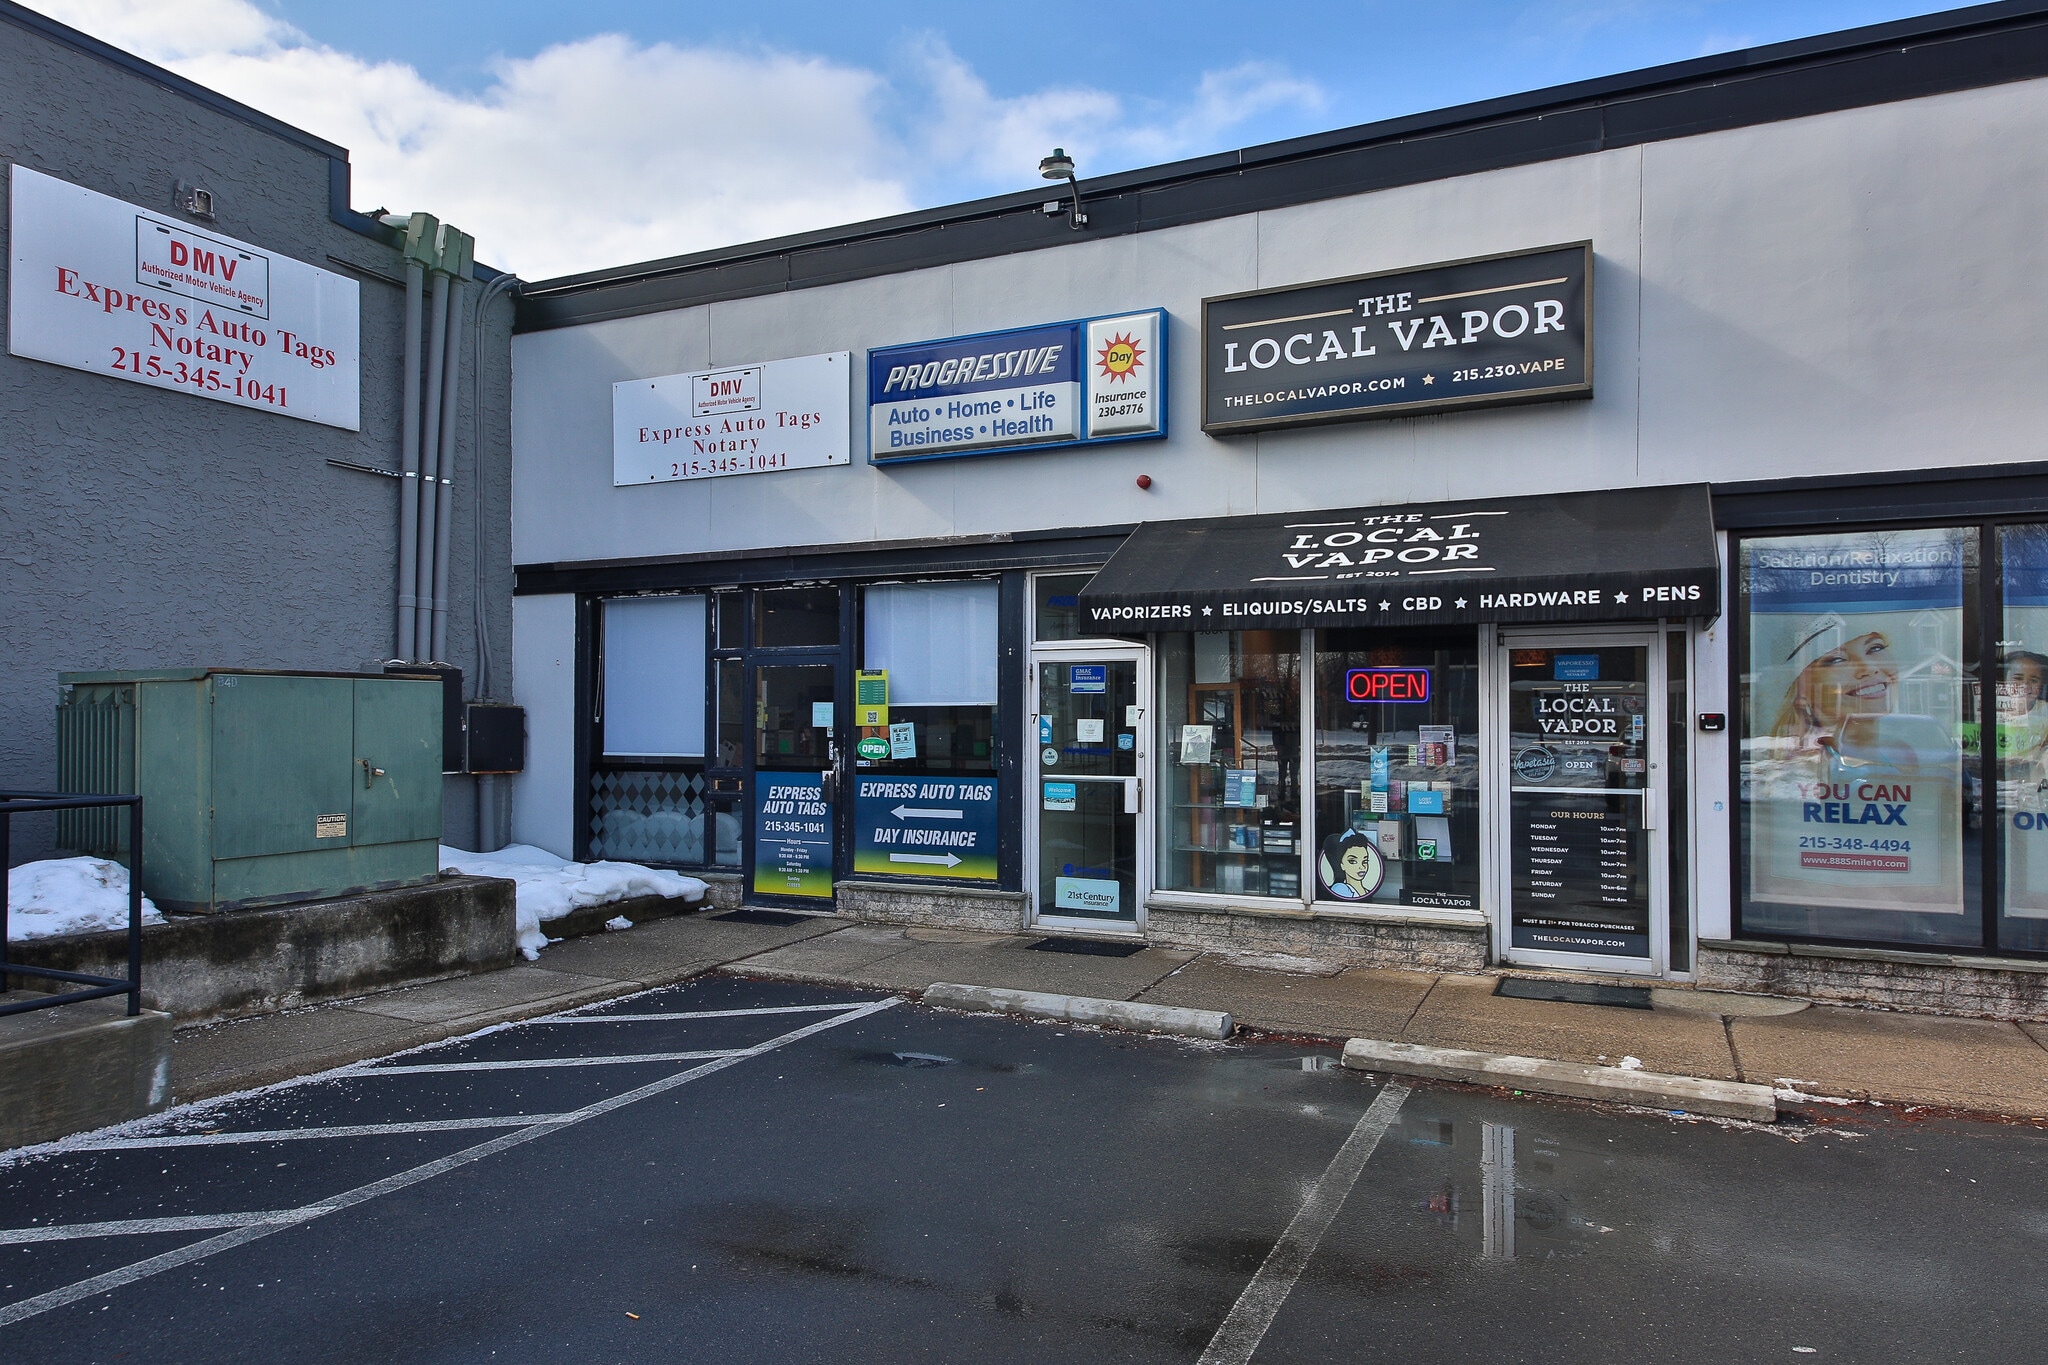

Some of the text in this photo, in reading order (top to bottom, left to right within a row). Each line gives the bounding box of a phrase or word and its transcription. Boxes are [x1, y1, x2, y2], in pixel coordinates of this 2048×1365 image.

[170, 240, 237, 282] DMV
[141, 261, 264, 308] Authorized Motor Vehicle Agency
[1358, 292, 1412, 318] THE
[55, 266, 336, 369] Express Auto Tags
[1224, 299, 1565, 373] LOCAL VAPOR
[149, 322, 254, 375] Notary
[1109, 351, 1132, 365] Day
[110, 346, 288, 408] 215-345-1041
[883, 345, 1064, 394] PROGRESSIVE
[710, 378, 742, 397] DMV
[1224, 358, 1565, 408] THELOCALVAPOR.COM 215.230.VAPE
[1094, 389, 1147, 404] Insurance
[888, 390, 1056, 426] Auto Home Life
[1098, 404, 1144, 418] 230-8776
[638, 410, 822, 444] Express Auto Tags
[890, 414, 1053, 448] Business Health
[693, 436, 760, 455] Notary
[671, 452, 788, 476] 215-345-1041
[1362, 513, 1424, 526] THE
[1290, 524, 1480, 549] LOCAL
[1281, 544, 1479, 568] VAPOR
[1759, 548, 1952, 569] Sedation/Relaxation
[1365, 570, 1400, 578] 2014
[1810, 570, 1900, 587] Dentistry
[1091, 585, 1700, 620] VAPORIZERS ELIQUIDS/SALTS CBD HARDWARE PENS
[1350, 674, 1426, 698] OPEN
[1564, 684, 1590, 692] THE
[1138, 708, 1145, 720] 7
[1539, 698, 1615, 712] LOCAL
[1031, 714, 1038, 724] 7
[1538, 719, 1616, 733] VAPOR
[862, 744, 886, 754] OPEN
[768, 786, 822, 801] EXPRESS
[860, 782, 992, 801] EXPRESS AUTO TAGS
[1797, 782, 1911, 802] YOU CAN
[763, 800, 827, 816] AUTO TAGS
[1550, 811, 1570, 819] OUR
[1803, 802, 1908, 826] RELAX
[765, 820, 825, 834] 215-345-1041
[874, 828, 976, 847] DAY INSURANCE
[1799, 836, 1911, 852] 215-348-4494
[1803, 856, 1906, 868] www.888Smile10.com
[1067, 890, 1115, 903] 21st Century
[1532, 934, 1625, 947] THELOCALVAPOR.COM
